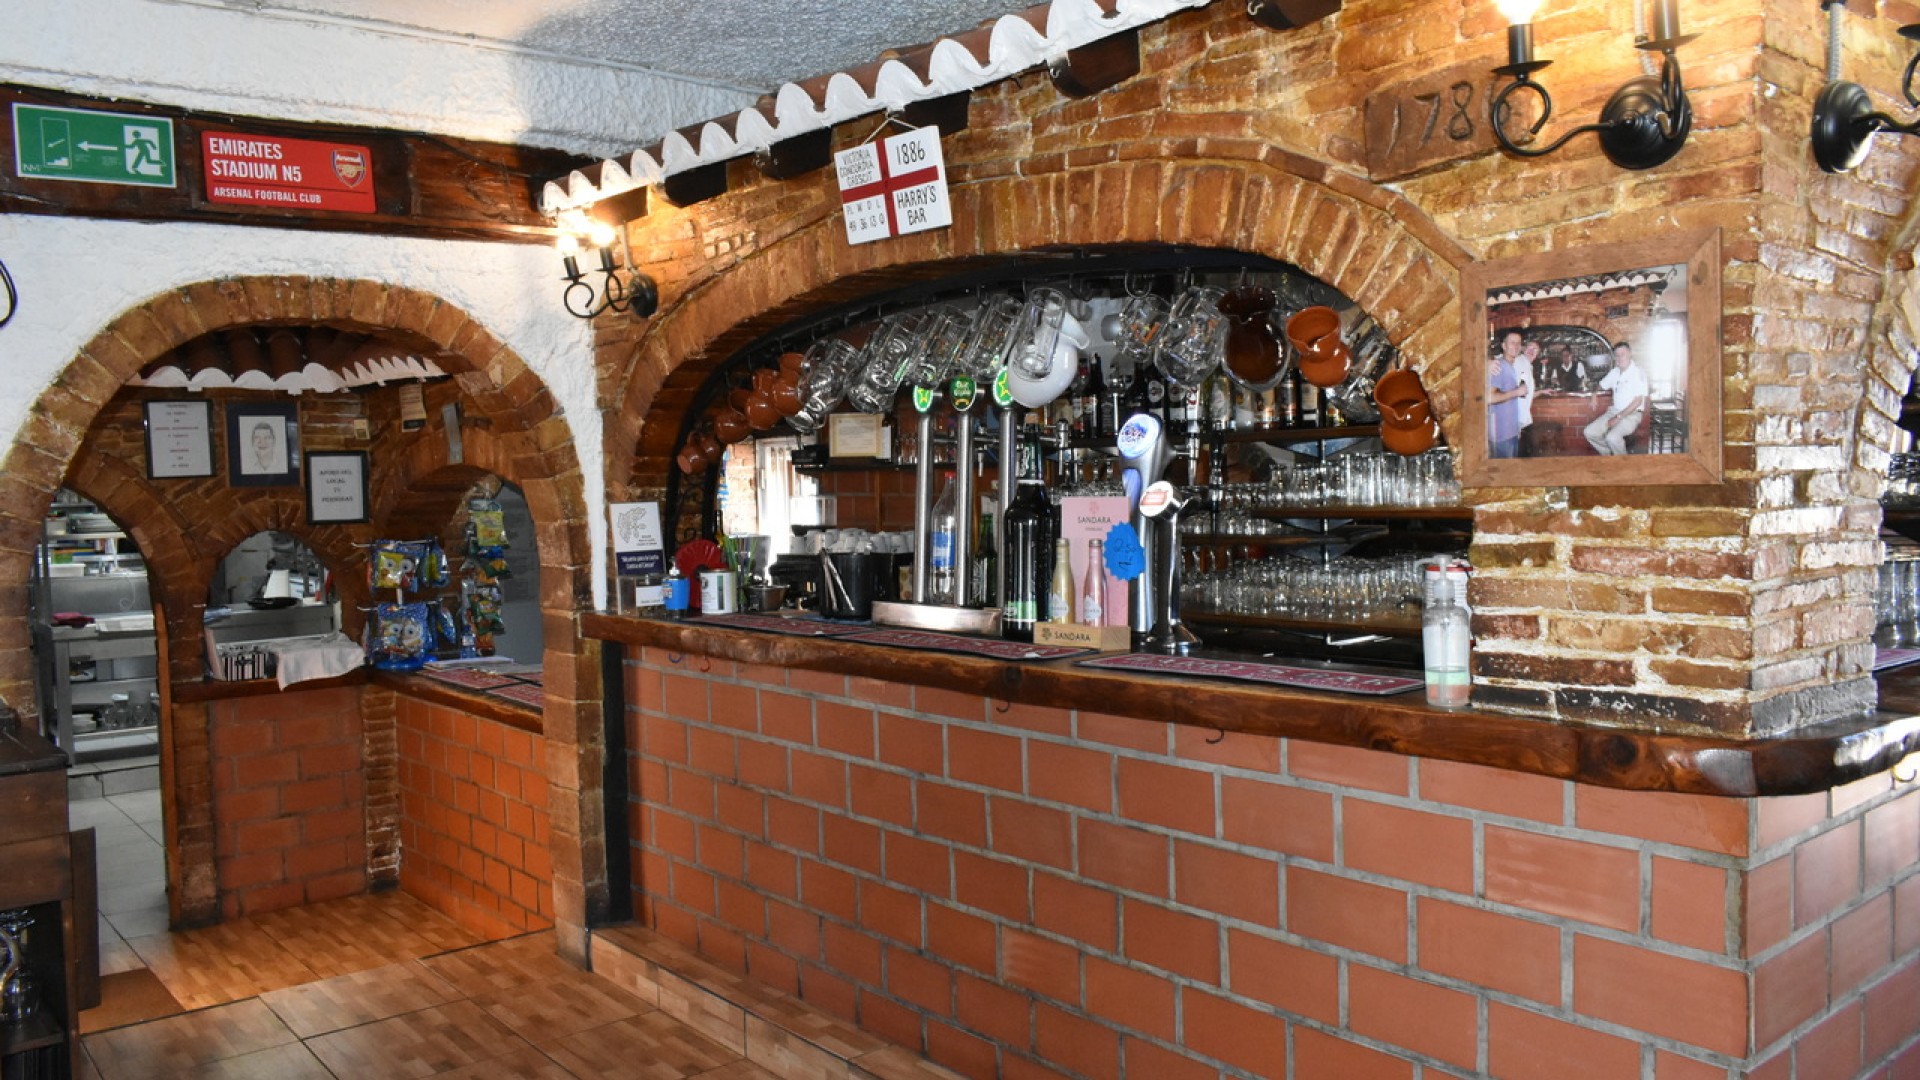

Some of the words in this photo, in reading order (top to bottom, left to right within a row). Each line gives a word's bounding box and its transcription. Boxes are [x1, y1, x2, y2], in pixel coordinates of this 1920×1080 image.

[209, 137, 283, 160] EMIRATES
[842, 149, 870, 166] VICTORIA
[896, 141, 926, 165] 1886
[211, 158, 277, 181] STADIUM
[282, 165, 302, 182] N5
[840, 161, 874, 178] CONCORDIA
[847, 171, 872, 187] CRESCIT
[214, 186, 253, 199] ARSENAL
[255, 190, 297, 203] FOOTBALL
[299, 193, 322, 204] CLUB
[896, 185, 937, 209] HARRY'S
[907, 208, 927, 226] BAR
[1077, 516, 1111, 525] SANDARA
[1054, 630, 1091, 642] SANDARA
